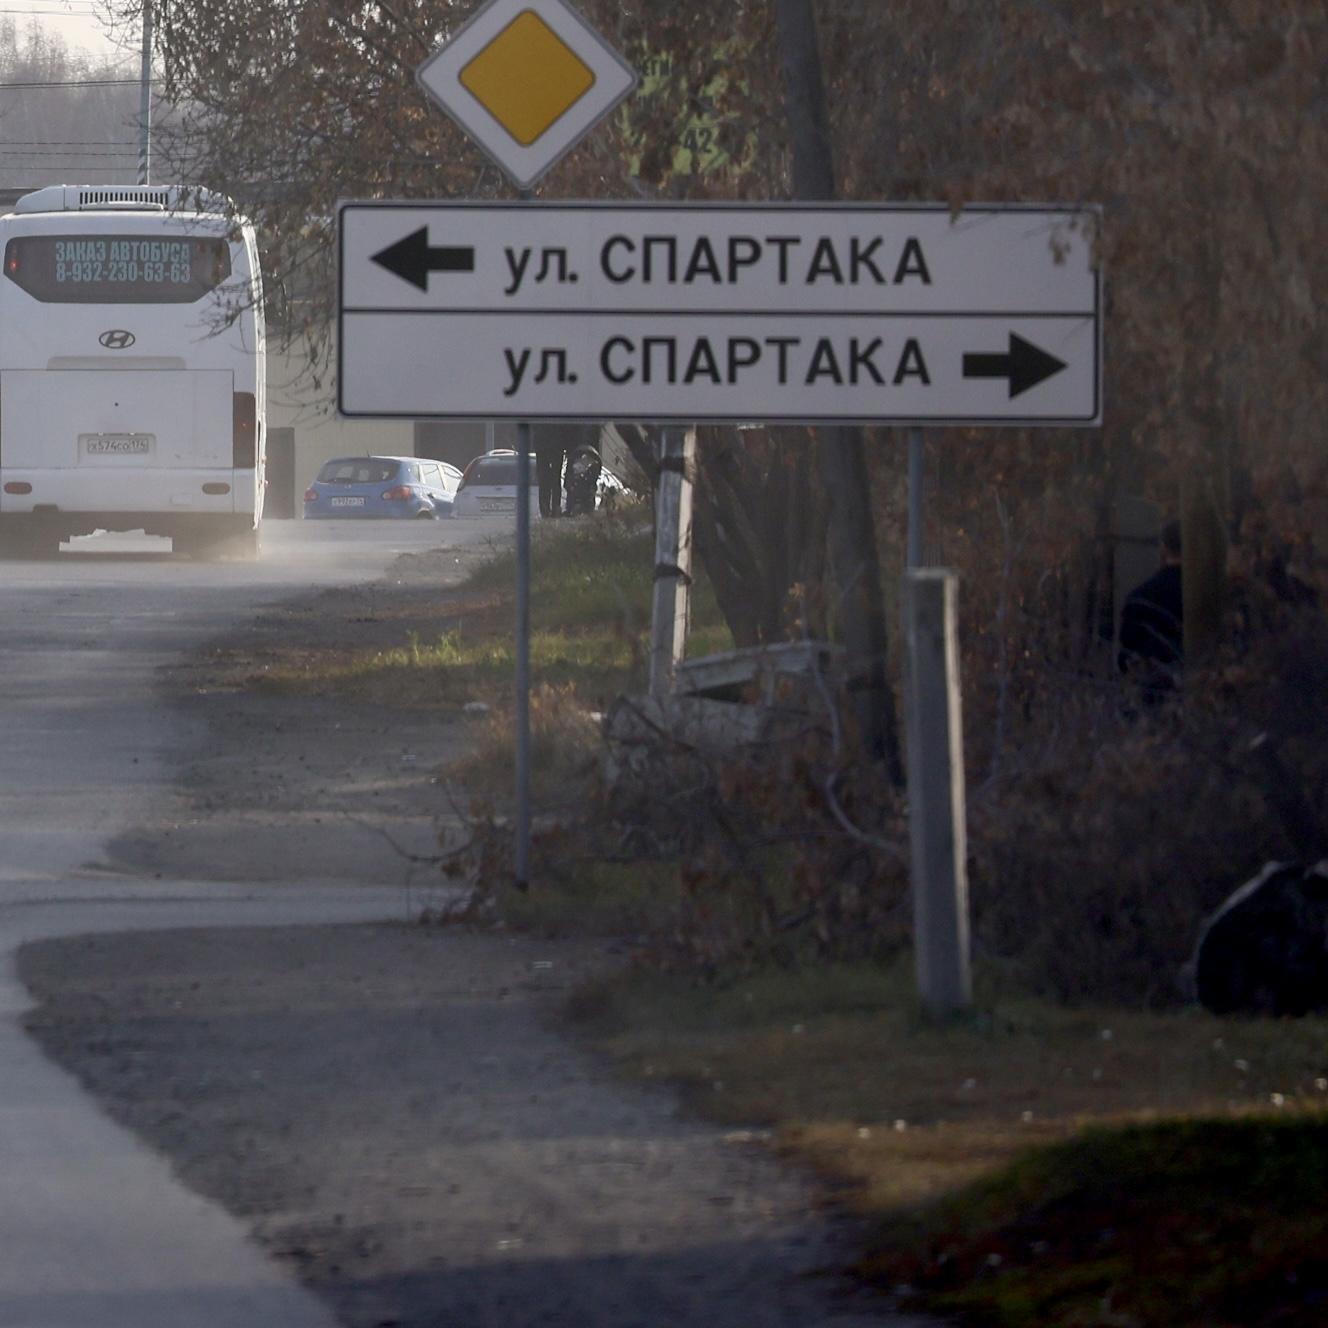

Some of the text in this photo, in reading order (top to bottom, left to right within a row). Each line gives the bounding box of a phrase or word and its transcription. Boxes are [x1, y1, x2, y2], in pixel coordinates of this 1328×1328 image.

[55, 241, 191, 263] ЗАКАЗ АВТОБУСА
[56, 262, 191, 283] 8-932-230-63-63
[504, 235, 932, 296] ул. СПАРТАКА
[503, 335, 931, 397] ул. СПАРТАКА
